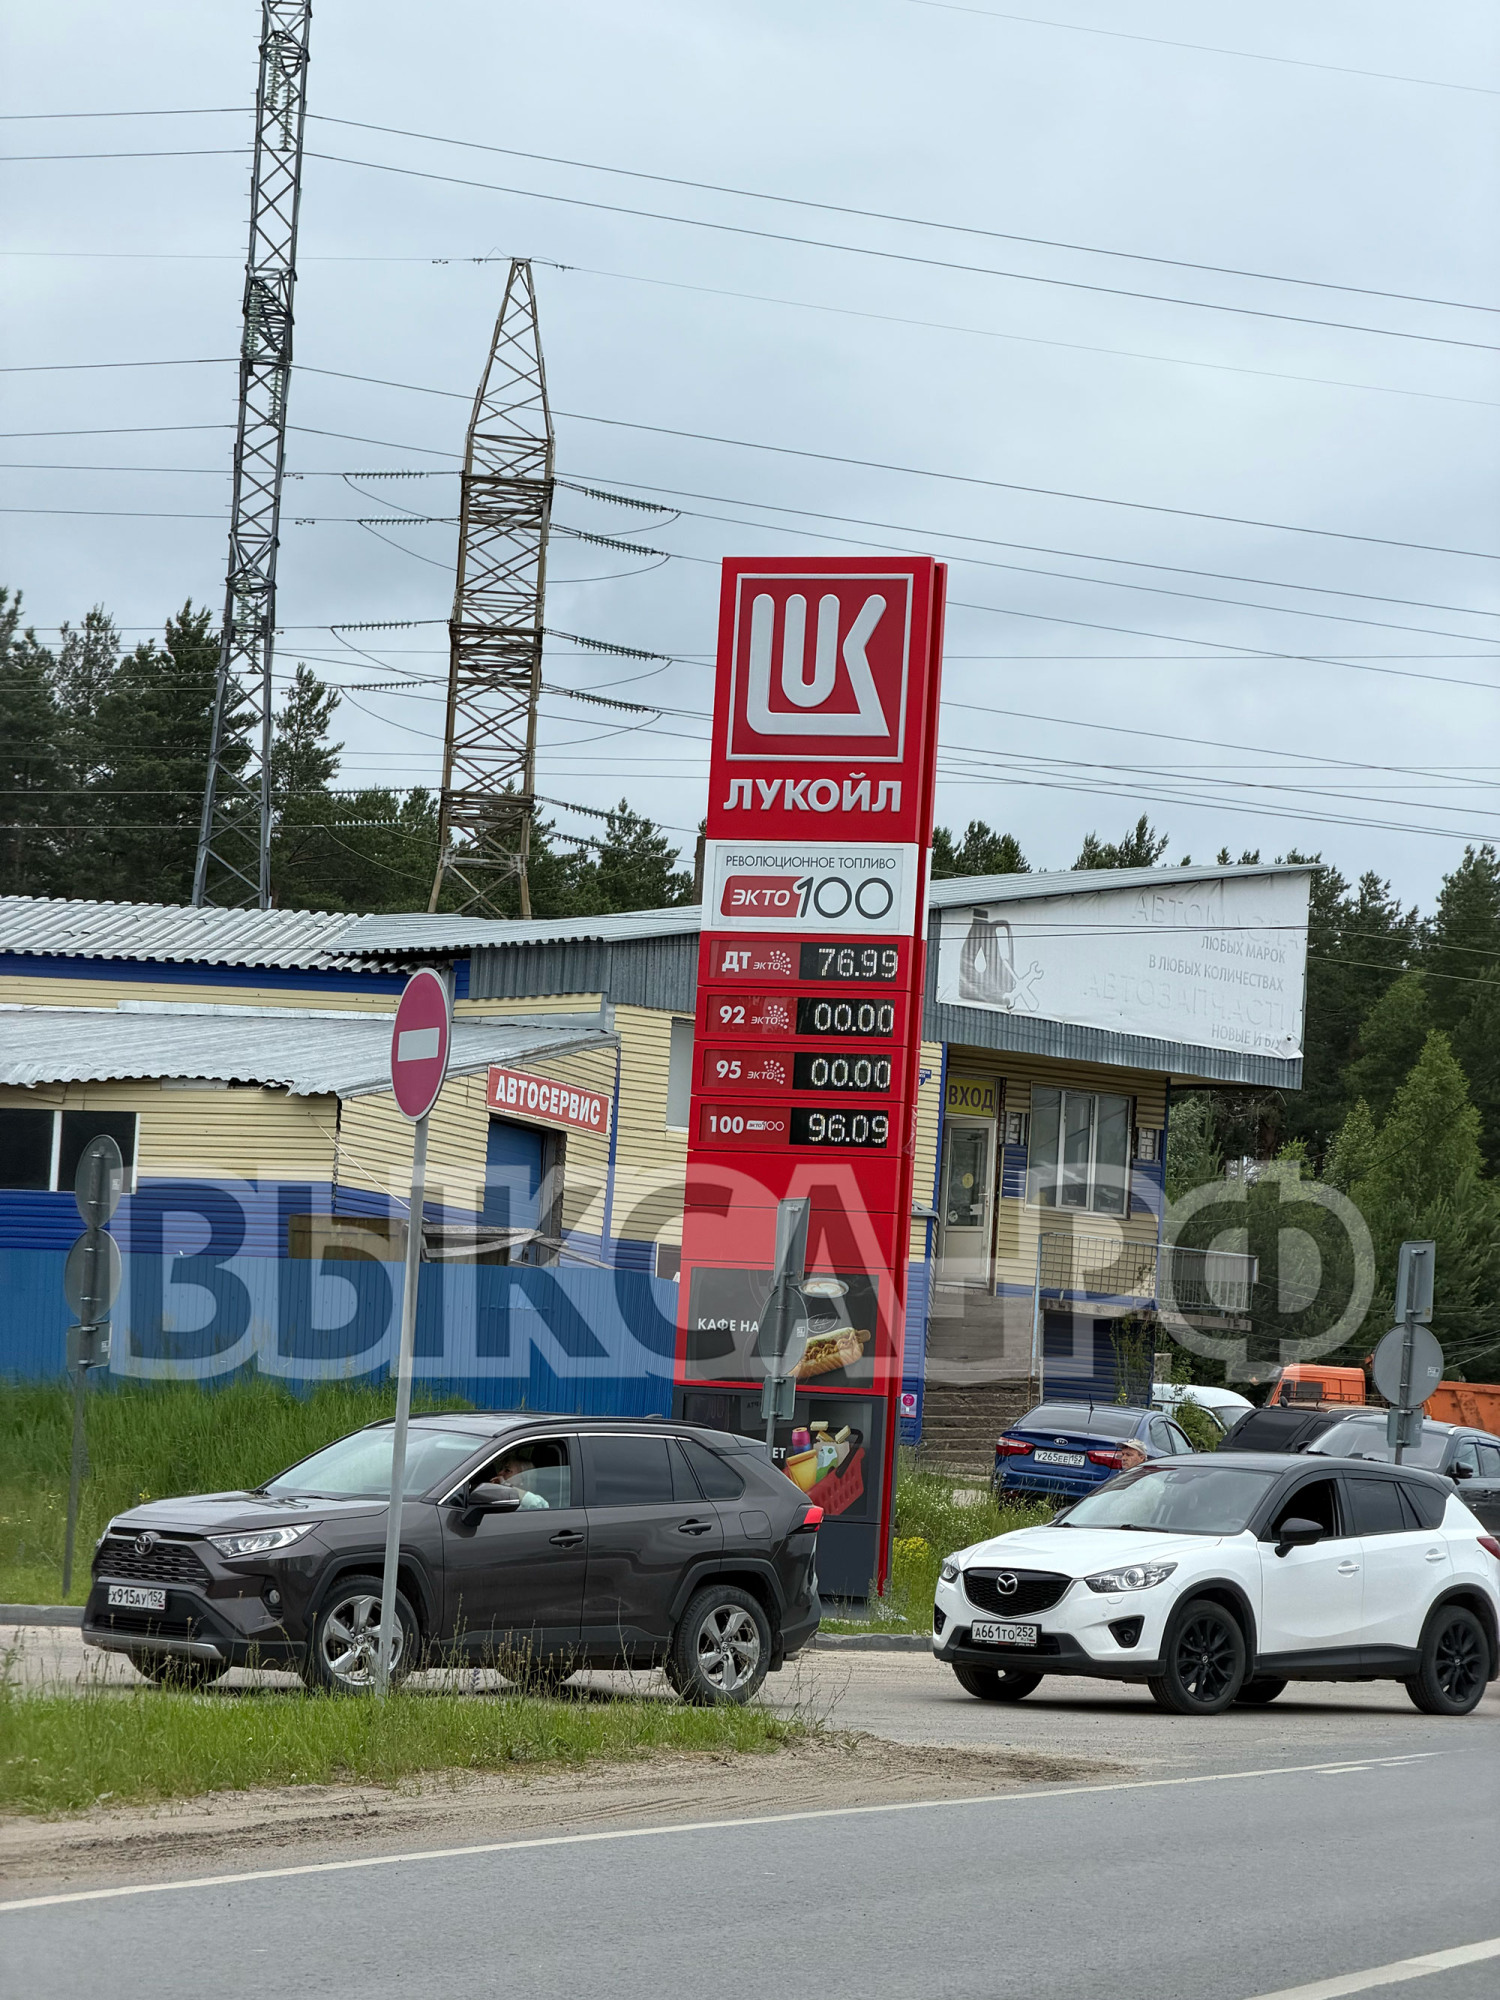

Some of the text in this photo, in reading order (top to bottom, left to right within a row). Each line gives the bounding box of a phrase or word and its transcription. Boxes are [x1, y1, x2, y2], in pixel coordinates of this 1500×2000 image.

[723, 772, 902, 813] ЛУКОЙЛ
[725, 855, 897, 869] РЕВОЛЮЦИОННОЕ ТОПЛИВО
[731, 876, 894, 920] ЭКТО 100
[722, 950, 781, 973] ДТ ЭКТО
[818, 948, 899, 978] 76.99
[1201, 935, 1286, 964] ЛЮБЫХ МАРОК
[1149, 954, 1284, 992] В ЛЮБЫХ КОЛИЧЕСТВАХ
[719, 1005, 778, 1025] 92 ЭКТО
[814, 1002, 895, 1033] 00.00
[1211, 1023, 1252, 1044] НОВЫЕ
[1254, 1032, 1262, 1047] И
[716, 1060, 774, 1080] 95 ЭКТО
[811, 1058, 891, 1088] 00.00
[495, 1074, 601, 1126] АВТОСЕРВИС
[948, 1084, 994, 1112] ВХОД
[709, 1115, 744, 1134] 100
[808, 1113, 889, 1143] 96.09
[697, 1318, 737, 1332] КАФЕ
[1016, 1627, 1034, 1638] 252
